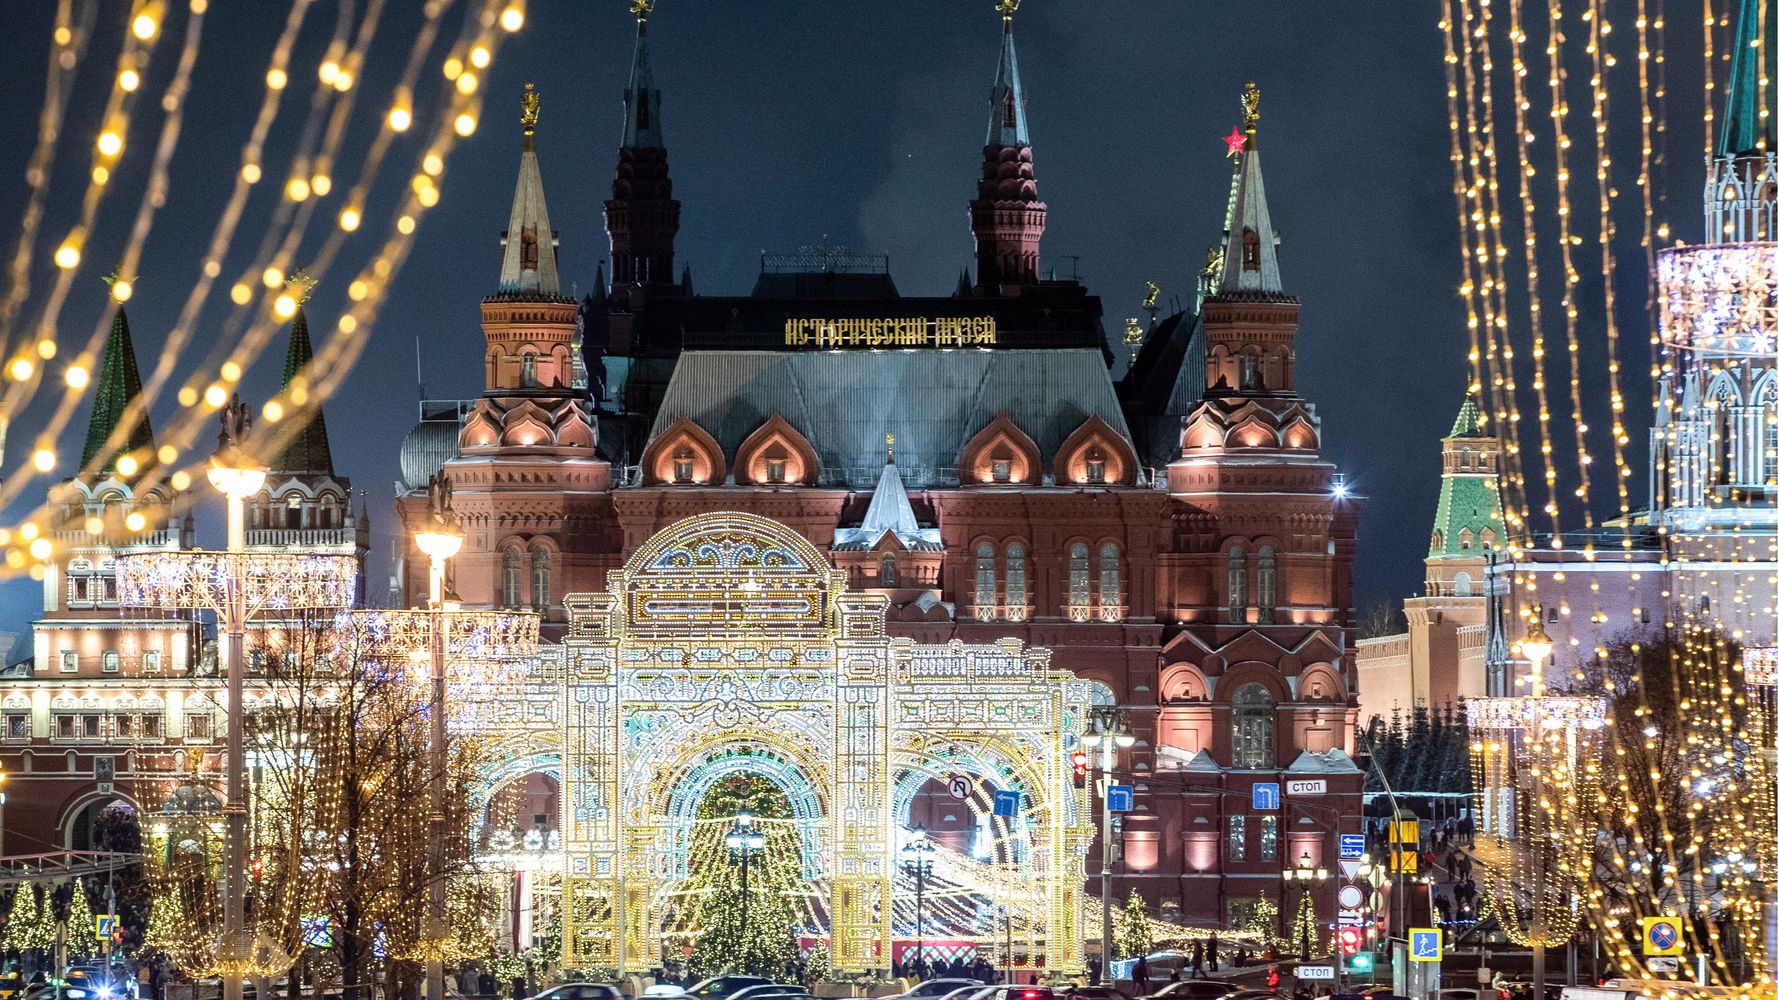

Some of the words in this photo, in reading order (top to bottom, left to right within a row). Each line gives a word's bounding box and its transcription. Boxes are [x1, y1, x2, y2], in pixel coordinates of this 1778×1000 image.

[786, 316, 928, 345] ИСТОРИЧЕСКИЙ
[935, 315, 995, 345] МУЗЕЙ
[1292, 782, 1321, 792] СТОП
[1303, 968, 1330, 977] СТОП
